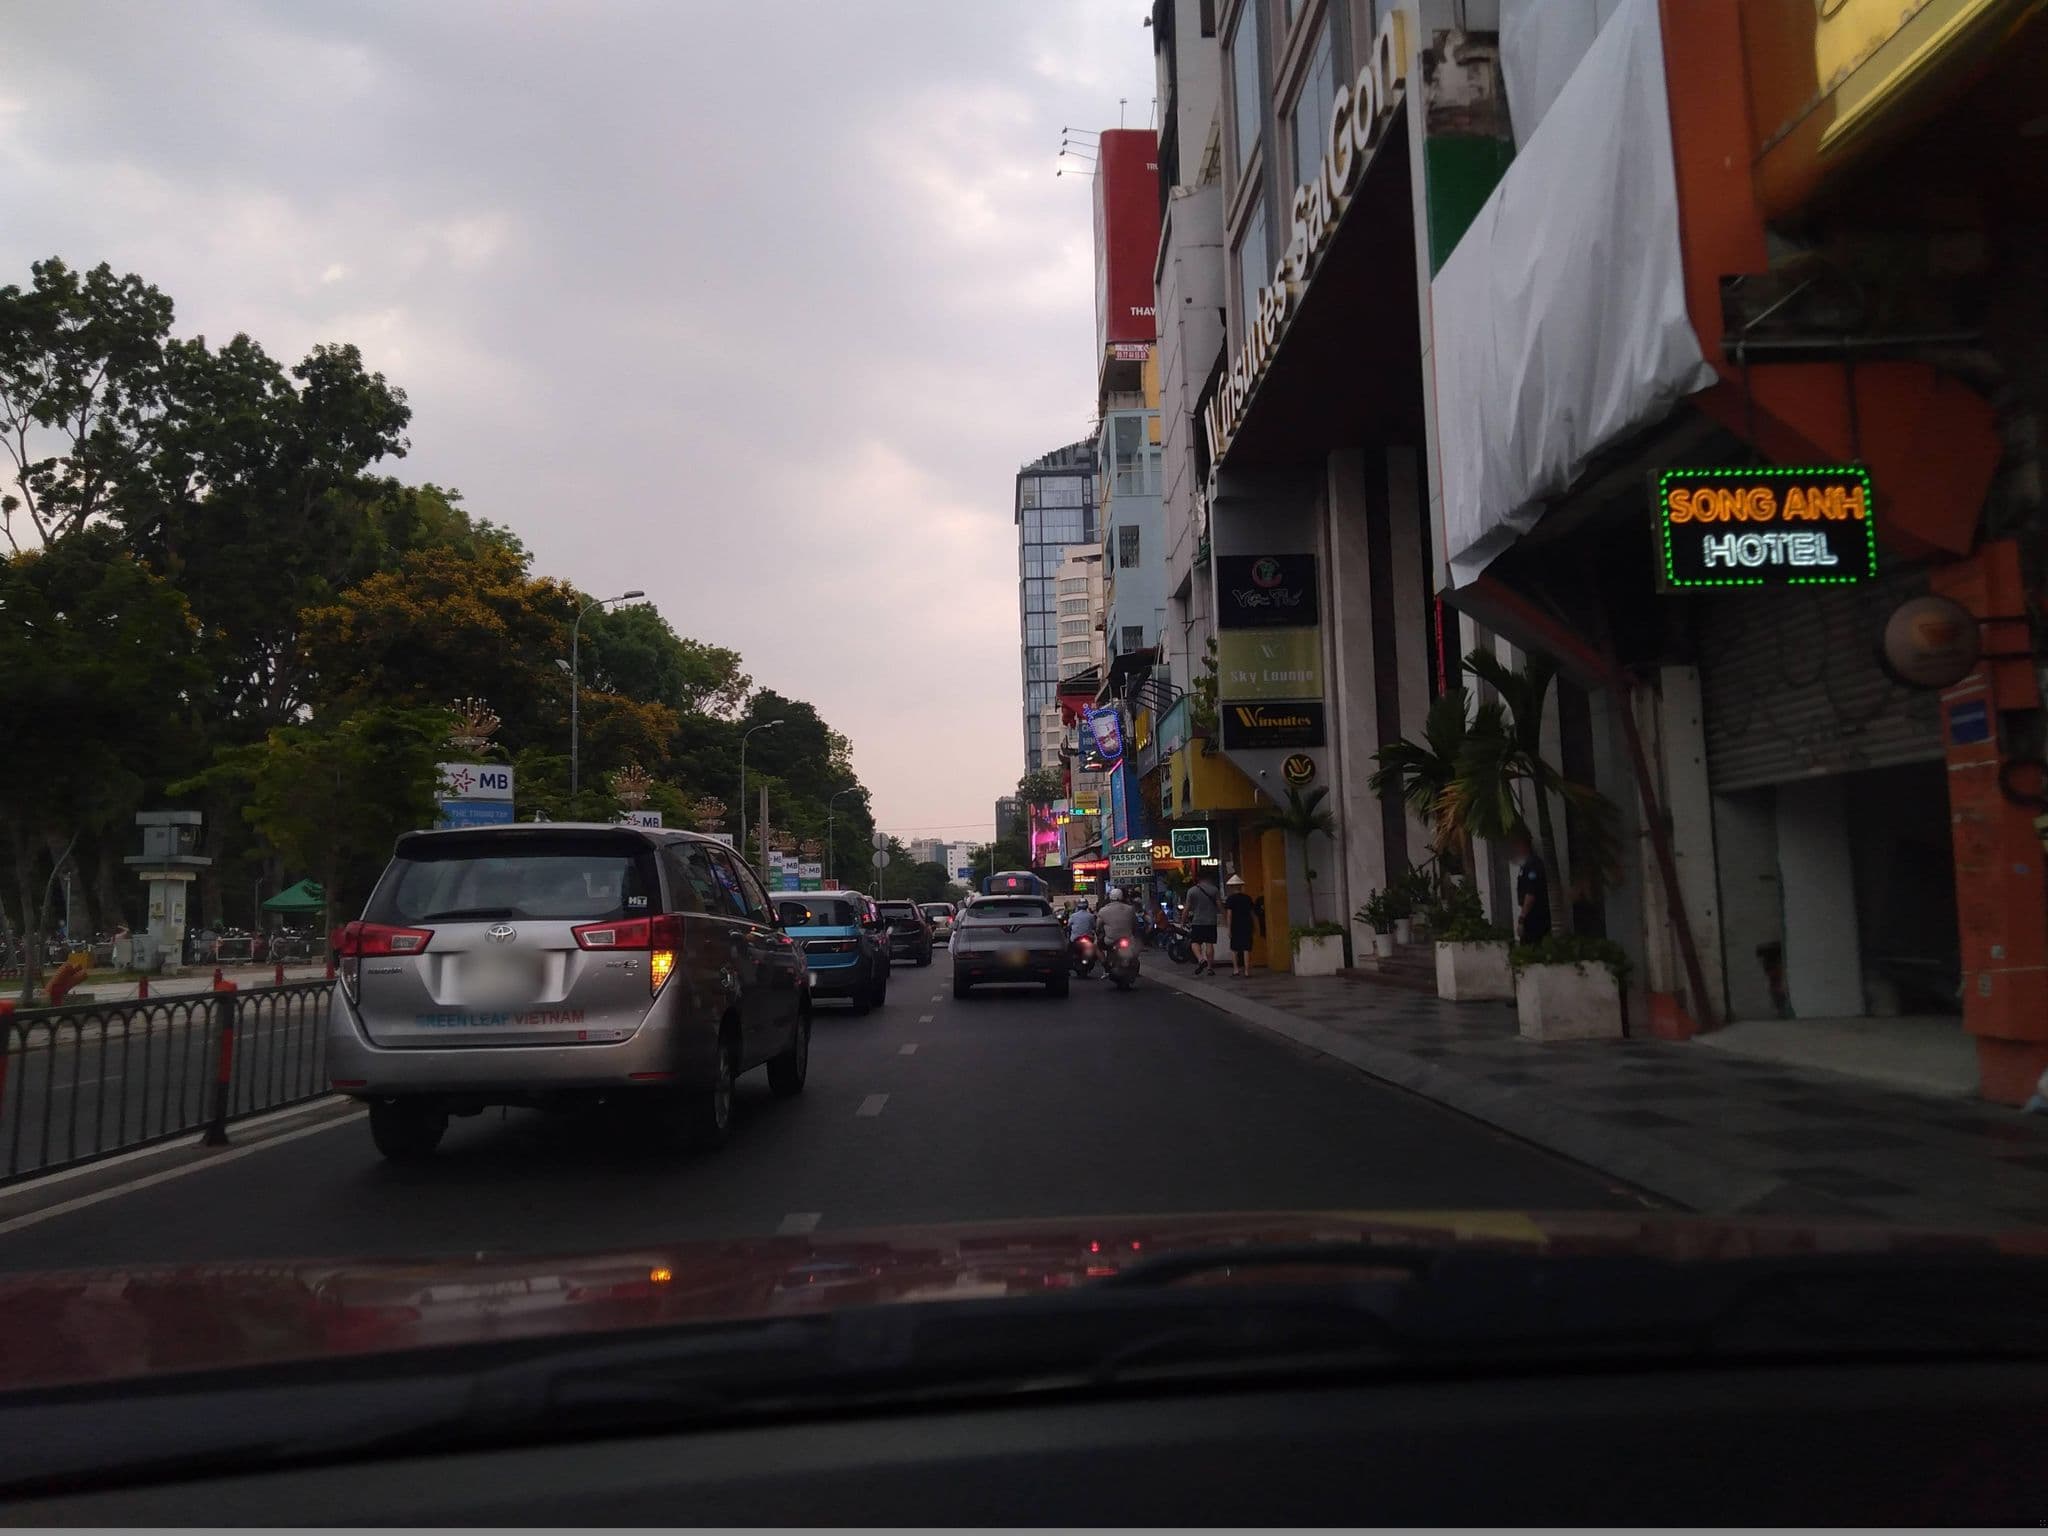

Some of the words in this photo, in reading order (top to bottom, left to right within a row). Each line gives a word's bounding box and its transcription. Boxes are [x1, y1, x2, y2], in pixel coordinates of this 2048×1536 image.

[1668, 487, 1778, 524] SONG
[1782, 486, 1866, 522] ANH
[1702, 532, 1839, 568] HOTEL
[1230, 670, 1258, 685] Sky
[480, 773, 508, 789] MB
[512, 1009, 585, 1026] VIETNAM
